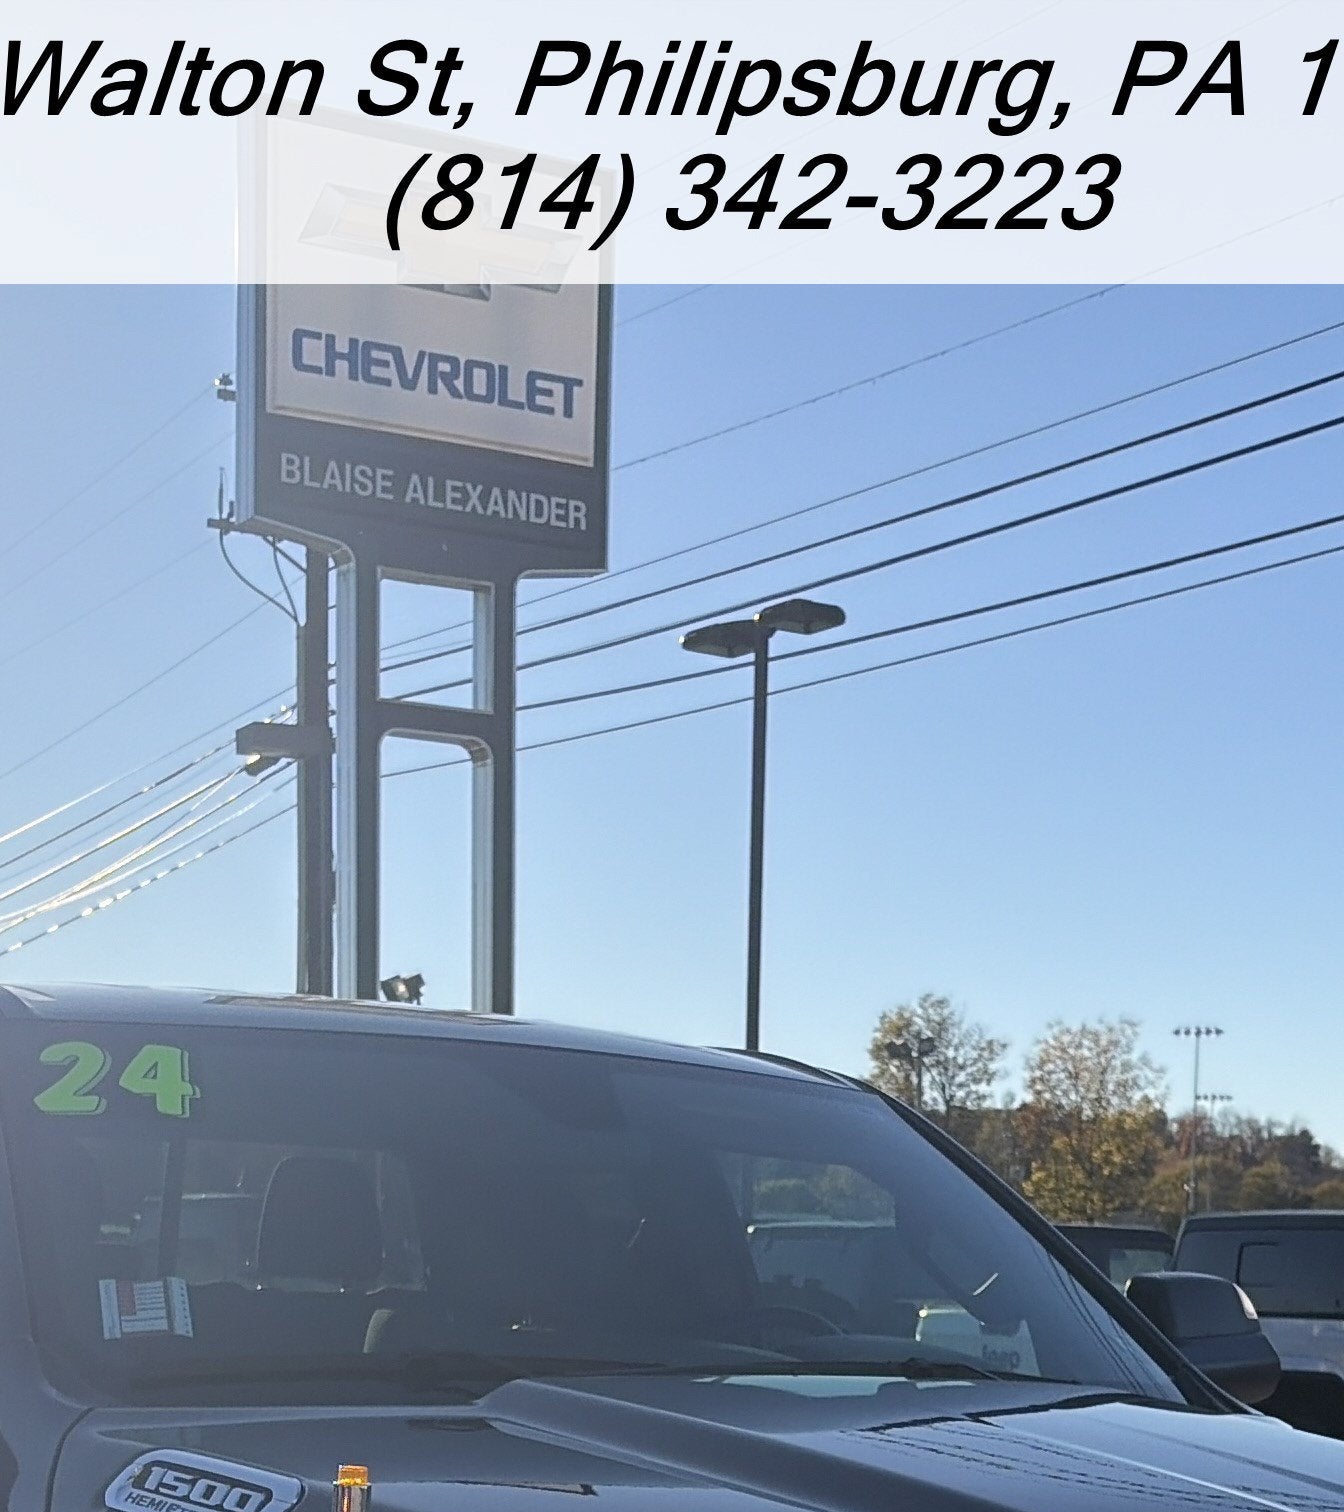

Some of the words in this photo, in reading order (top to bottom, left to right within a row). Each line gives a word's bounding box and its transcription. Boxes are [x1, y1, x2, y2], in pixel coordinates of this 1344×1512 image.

[291, 327, 584, 420] CHEVROLET
[279, 452, 396, 500] BLAISE
[404, 473, 588, 532] ALEXANDER
[33, 1040, 202, 1119] 24
[125, 1491, 166, 1512] HEMI
